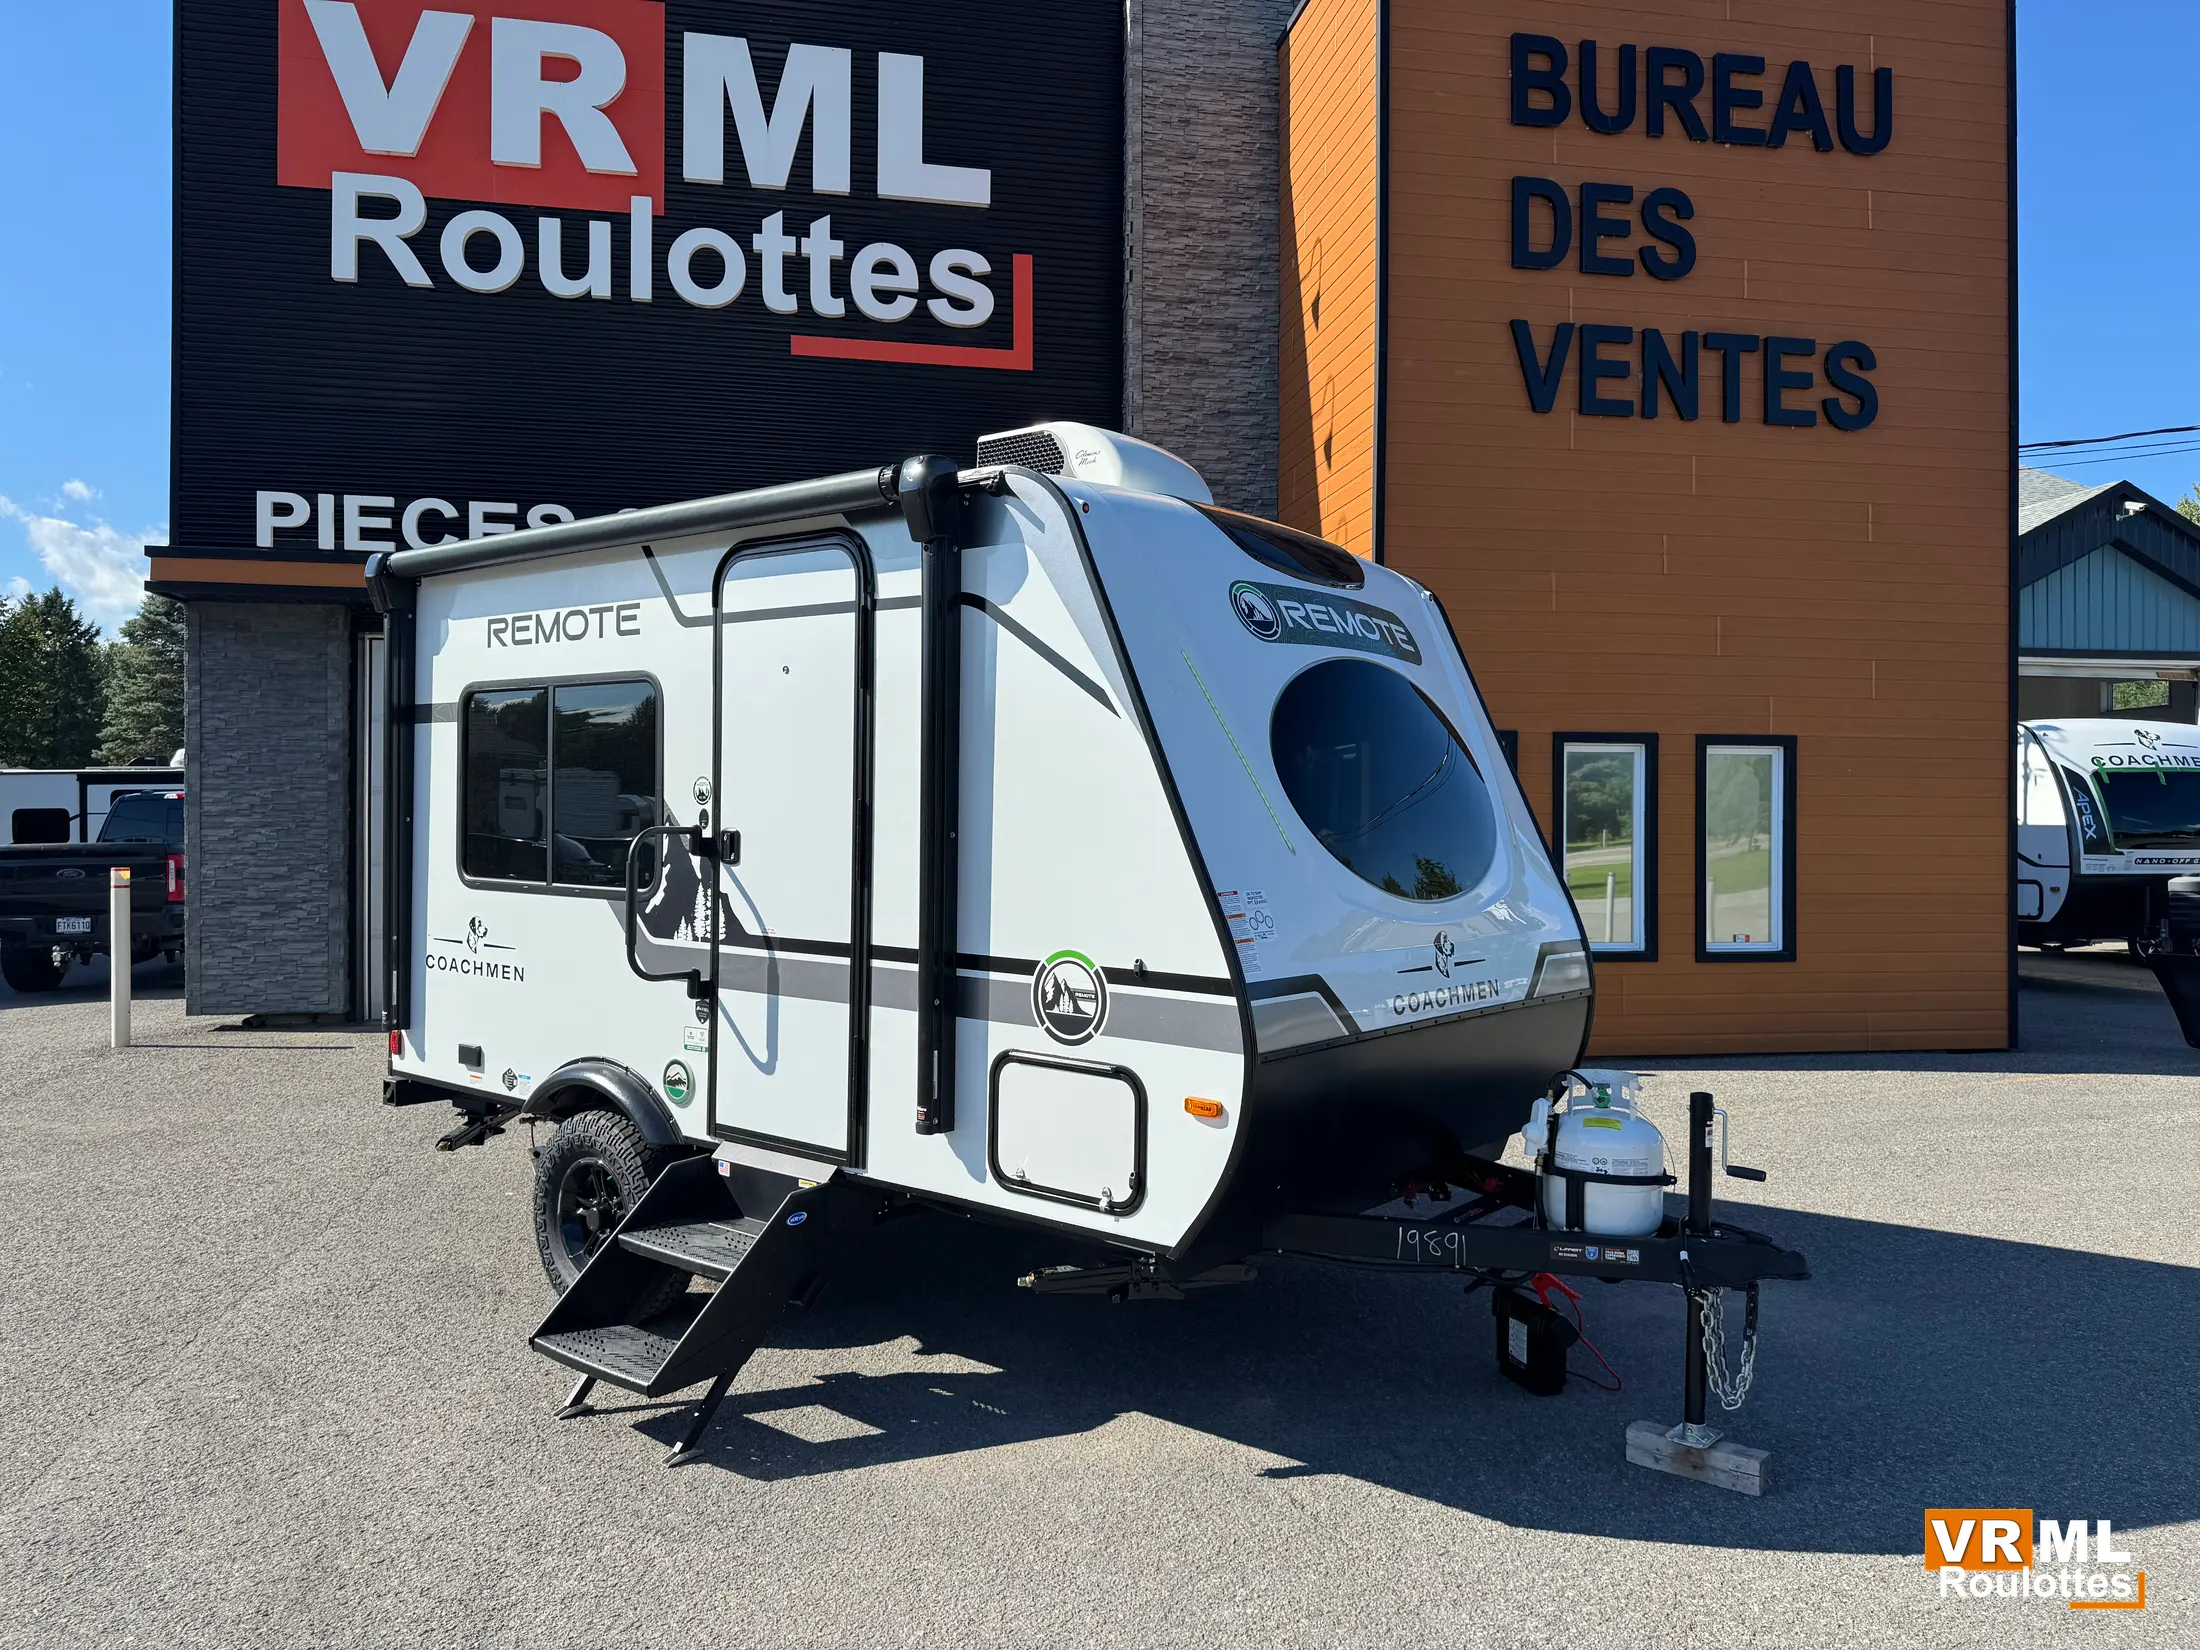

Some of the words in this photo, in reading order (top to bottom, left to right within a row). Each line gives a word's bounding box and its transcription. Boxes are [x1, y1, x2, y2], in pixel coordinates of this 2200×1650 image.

[1510, 32, 1893, 155] BUREAU
[330, 171, 996, 328] Roulottes
[1511, 176, 1697, 281] DES
[1509, 319, 1879, 431] VENTES
[487, 602, 640, 648] REMOTE
[1276, 599, 1415, 652] REMOTE
[2073, 786, 2096, 840] APEX
[425, 954, 525, 983] COACHMEN
[1393, 979, 1500, 1016] COACHMEN
[1396, 1226, 1467, 1265] 19891
